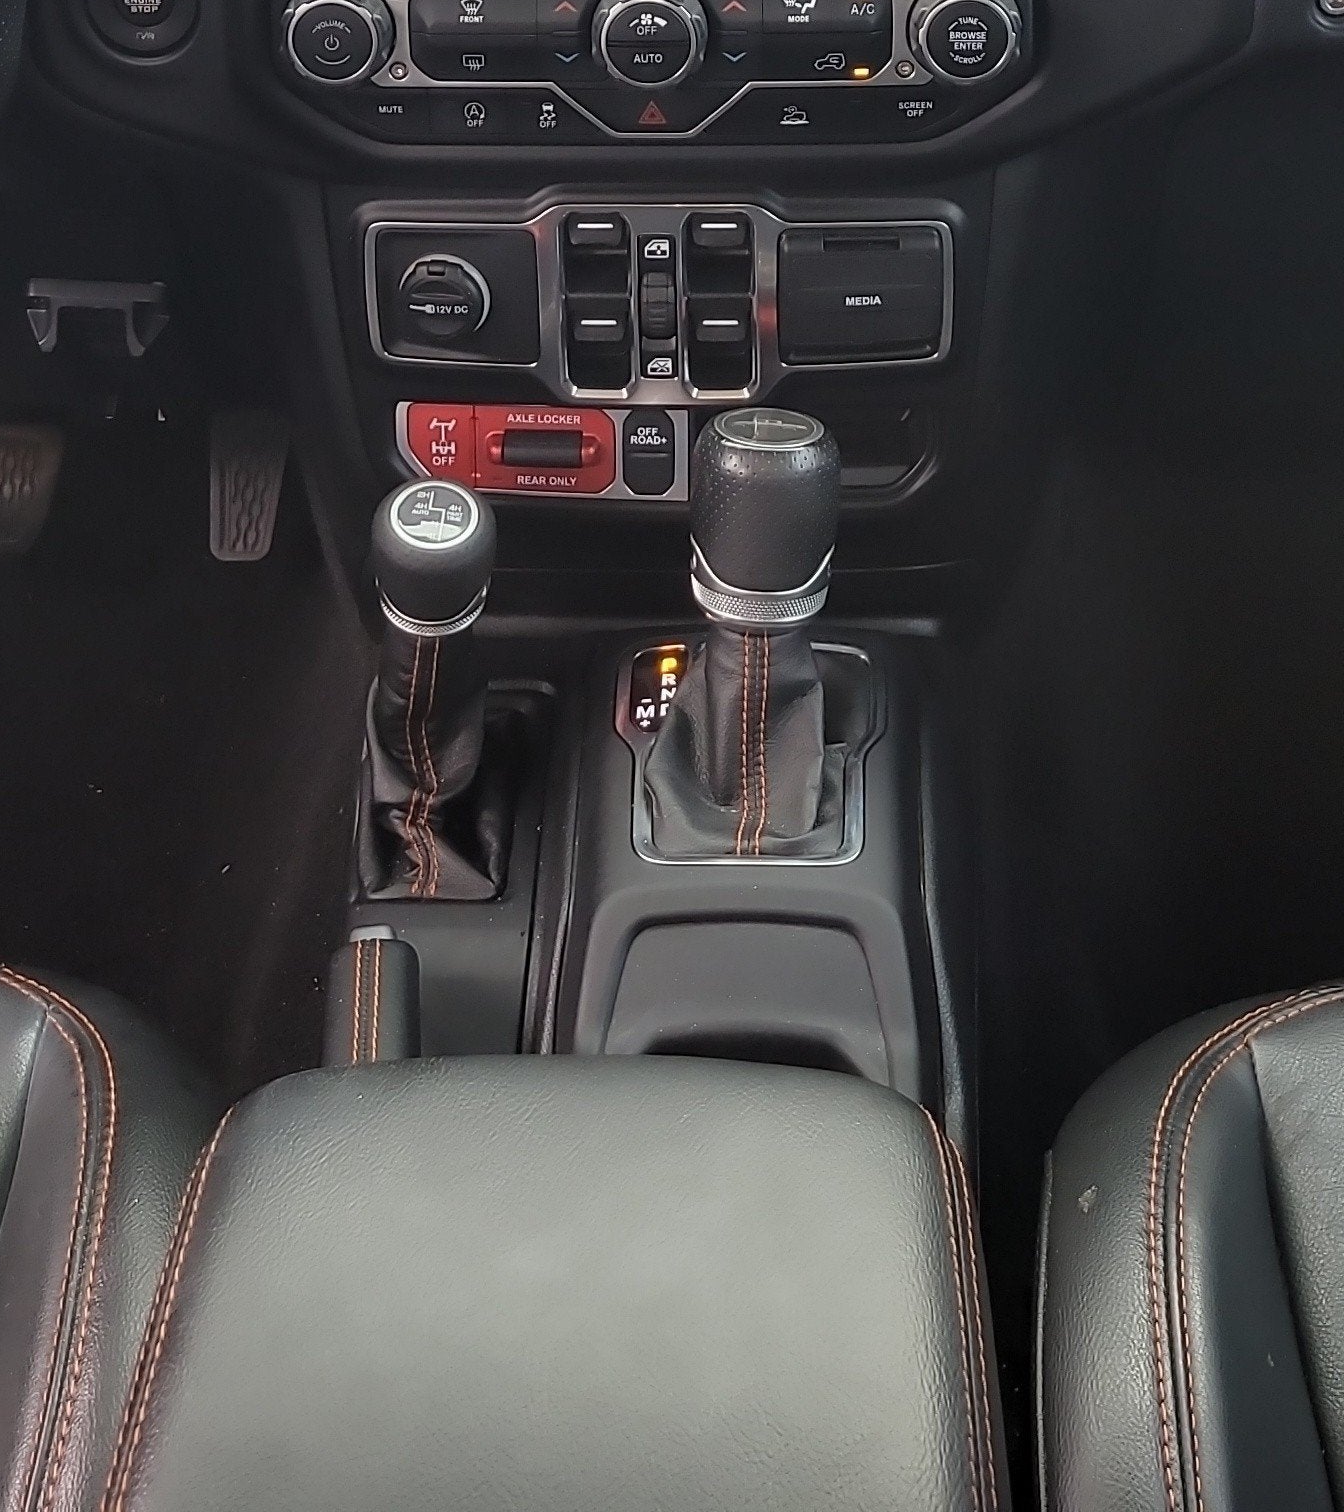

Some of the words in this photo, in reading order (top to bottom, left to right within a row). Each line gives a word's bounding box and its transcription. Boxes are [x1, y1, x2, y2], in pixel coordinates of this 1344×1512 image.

[130, 5, 159, 13] STOP
[850, 3, 875, 17] A/C
[315, 19, 346, 31] VOLUME
[459, 15, 484, 24] FRONT
[787, 15, 810, 24] MODE
[957, 16, 979, 27] TUNE
[636, 25, 658, 37] OFF
[949, 31, 987, 41] BROWSE
[953, 41, 983, 51] ENTER
[633, 53, 663, 65] AUTO
[953, 53, 984, 65] SCROLL
[378, 104, 404, 115] MUTE
[898, 100, 934, 111] SCREEN
[906, 108, 925, 118] OFF
[467, 117, 484, 128] OFF
[539, 119, 557, 129] OFF
[845, 294, 882, 307] MEDIA
[436, 304, 454, 314] 12V
[454, 303, 469, 314] DC
[506, 413, 534, 425] AXLE
[536, 413, 581, 425] LOCKER
[636, 426, 659, 437] OFF
[630, 434, 668, 446] ROAD+
[432, 455, 456, 467] OFF
[517, 475, 546, 487] REAR
[548, 475, 578, 486] ONLY
[414, 501, 429, 509] 4H
[661, 657, 677, 673] P
[661, 673, 677, 686] R
[660, 687, 677, 701] N
[636, 704, 655, 719] M
